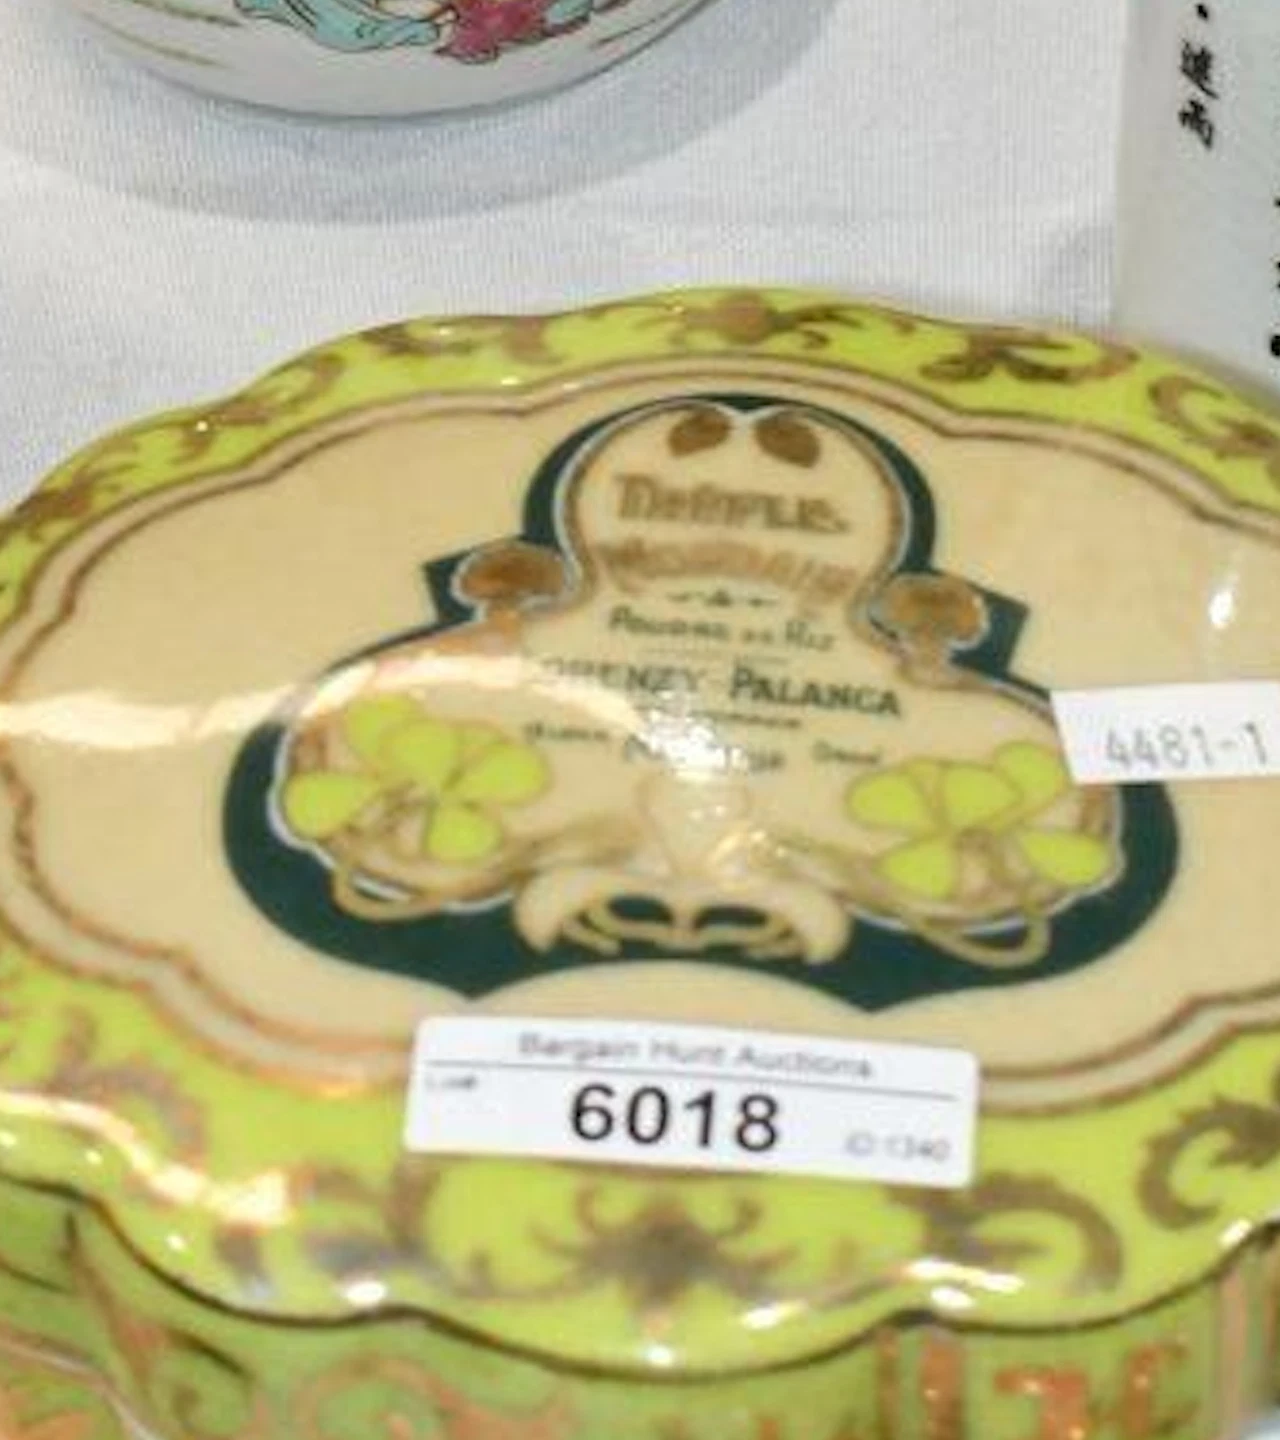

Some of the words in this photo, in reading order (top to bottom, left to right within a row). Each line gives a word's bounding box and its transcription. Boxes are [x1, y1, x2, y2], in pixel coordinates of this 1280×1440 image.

[1105, 720, 1268, 772] 4481-1
[519, 1031, 641, 1065] Bargain
[649, 1036, 724, 1069] Hunt
[734, 1045, 875, 1080] Auctions
[569, 1082, 780, 1154] 6018
